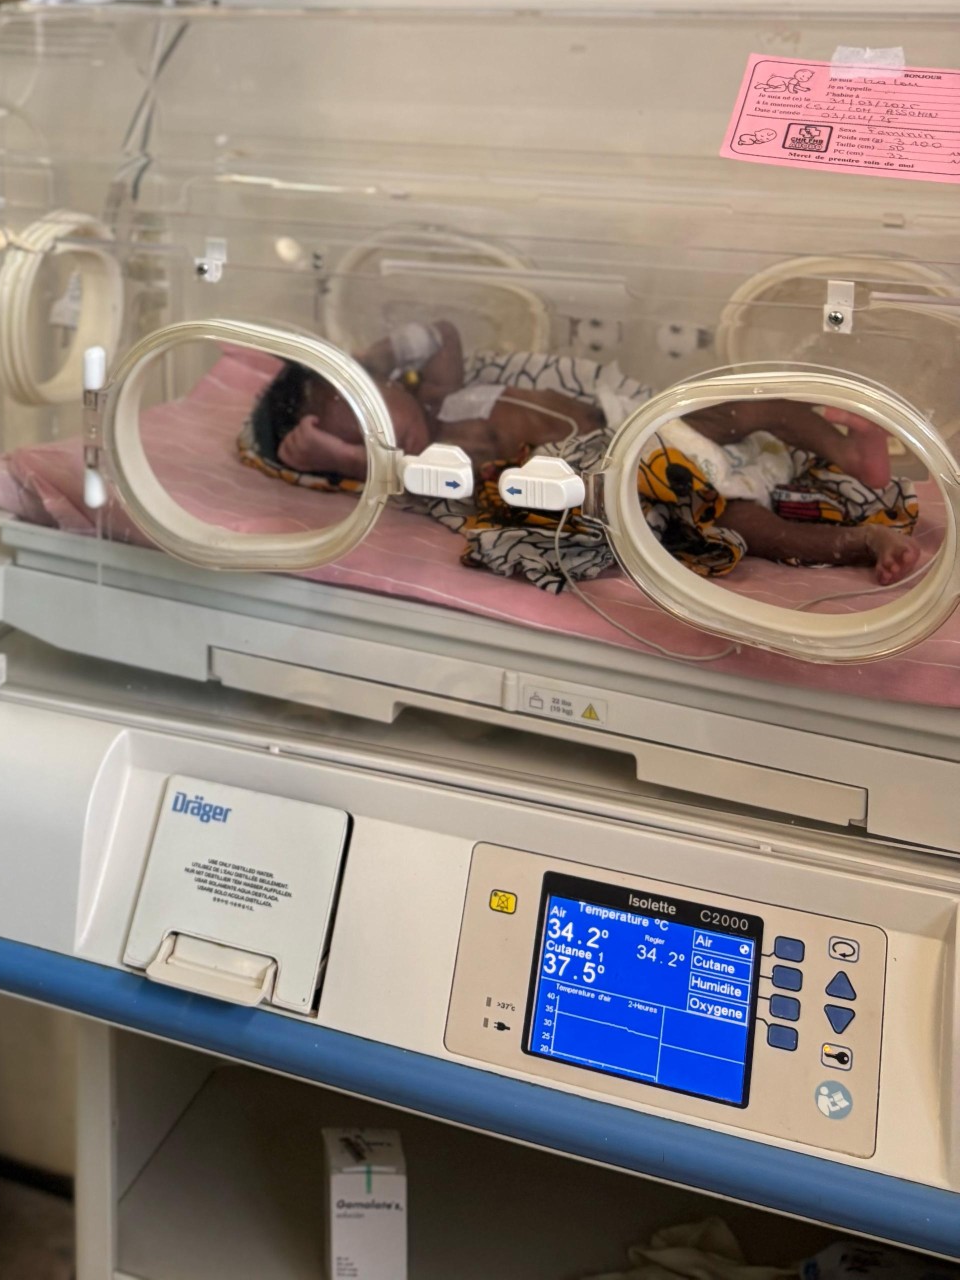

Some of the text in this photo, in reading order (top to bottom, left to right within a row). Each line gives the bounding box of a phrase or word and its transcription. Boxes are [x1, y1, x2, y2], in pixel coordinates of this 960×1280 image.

[551, 697, 560, 705] 22
[172, 791, 233, 824] Dräger
[232, 864, 256, 874] DISTILLED
[214, 888, 228, 896] SOLO
[550, 905, 567, 918] Air
[578, 901, 669, 931] Temperature °C
[628, 894, 749, 931] Isolette C2000
[644, 934, 666, 945] Regler
[695, 934, 713, 948] Air
[545, 940, 604, 962] Cutanee 1
[543, 953, 605, 983] 37.5°
[693, 955, 735, 974] Cutane
[556, 983, 612, 1003] Temperature d'air
[691, 975, 742, 997] Humidite
[547, 992, 555, 1000] 40
[545, 1005, 554, 1013] 35
[628, 1000, 658, 1014] 2-Heures
[690, 997, 743, 1019] Oxygene
[543, 1018, 552, 1027] 30
[541, 1031, 550, 1040] 25
[540, 1044, 549, 1053] 20
